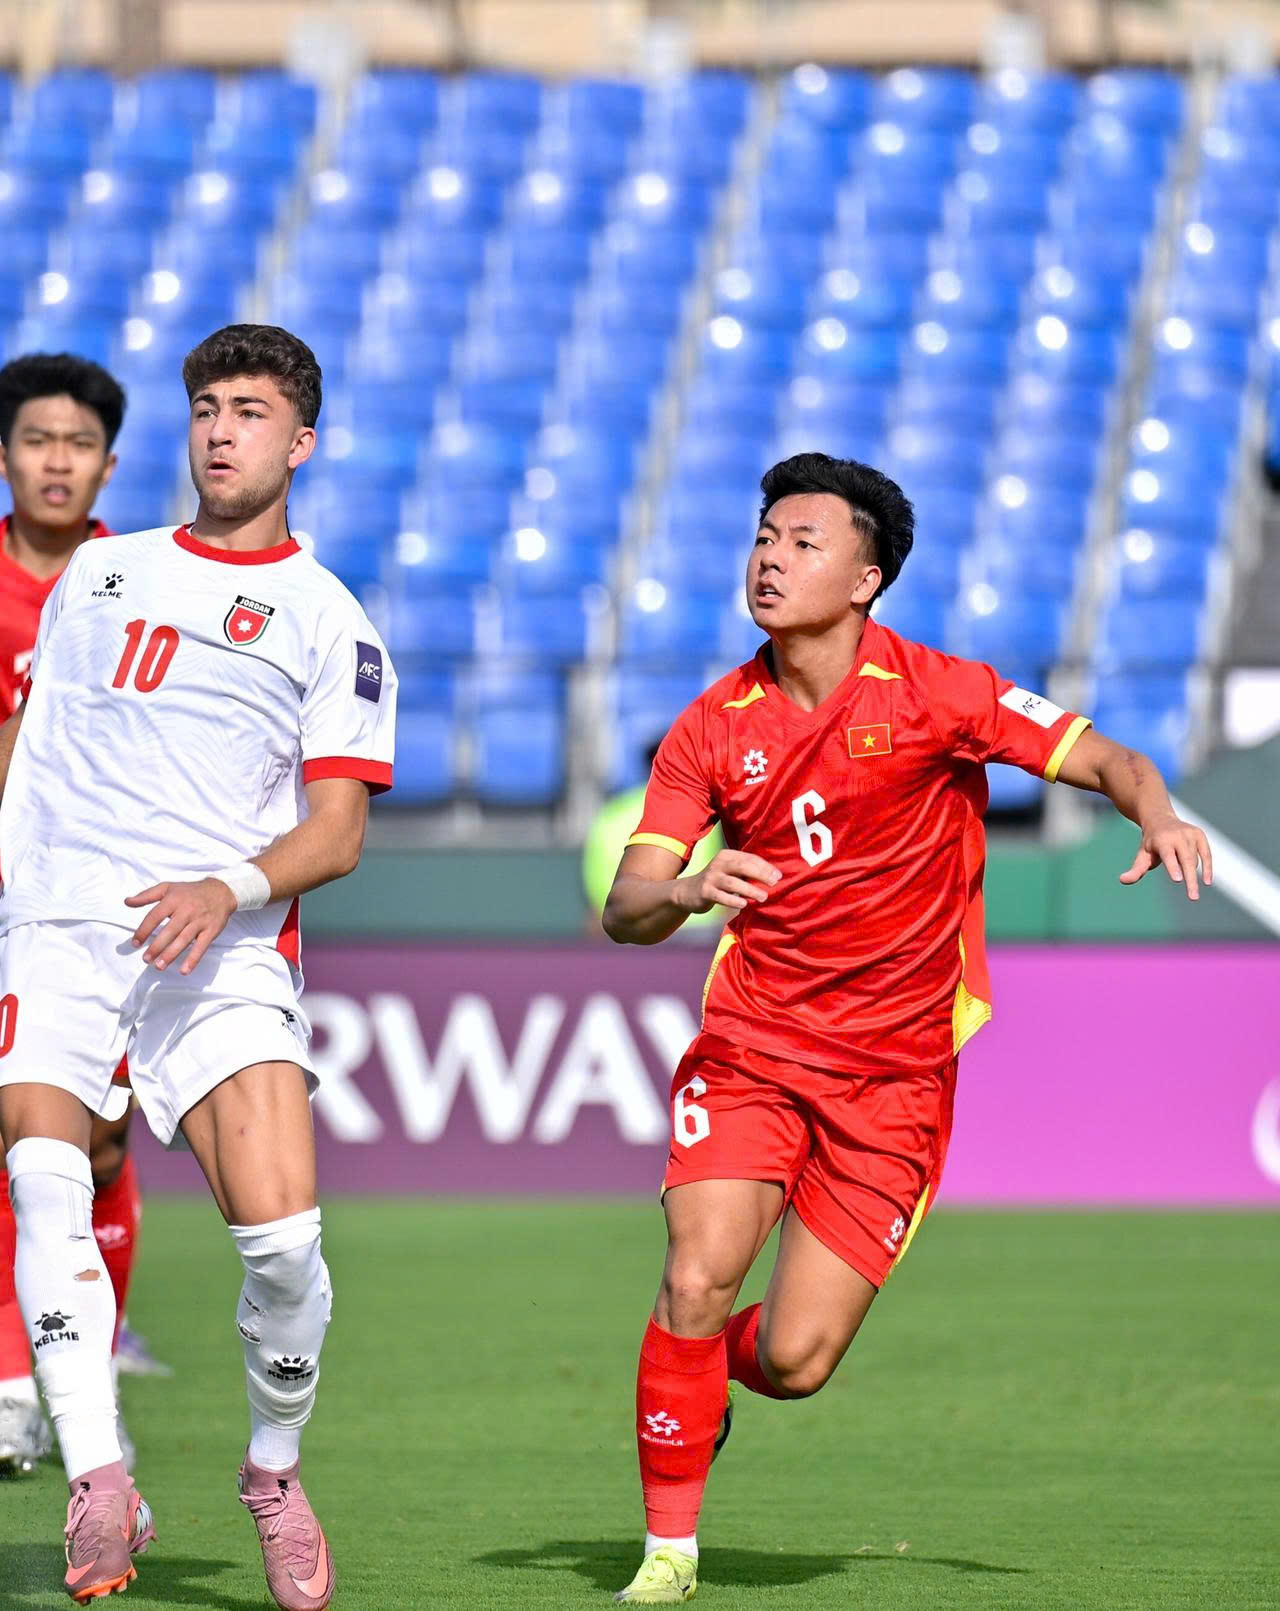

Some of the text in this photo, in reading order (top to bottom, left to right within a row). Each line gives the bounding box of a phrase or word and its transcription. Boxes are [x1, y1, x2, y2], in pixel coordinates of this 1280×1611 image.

[91, 590, 122, 599] KELME
[239, 598, 271, 615] JORDAN
[112, 619, 179, 693] 10
[358, 662, 380, 680] AFC
[791, 789, 833, 867] 6
[674, 1075, 710, 1148] 6
[34, 1331, 80, 1350] KELME
